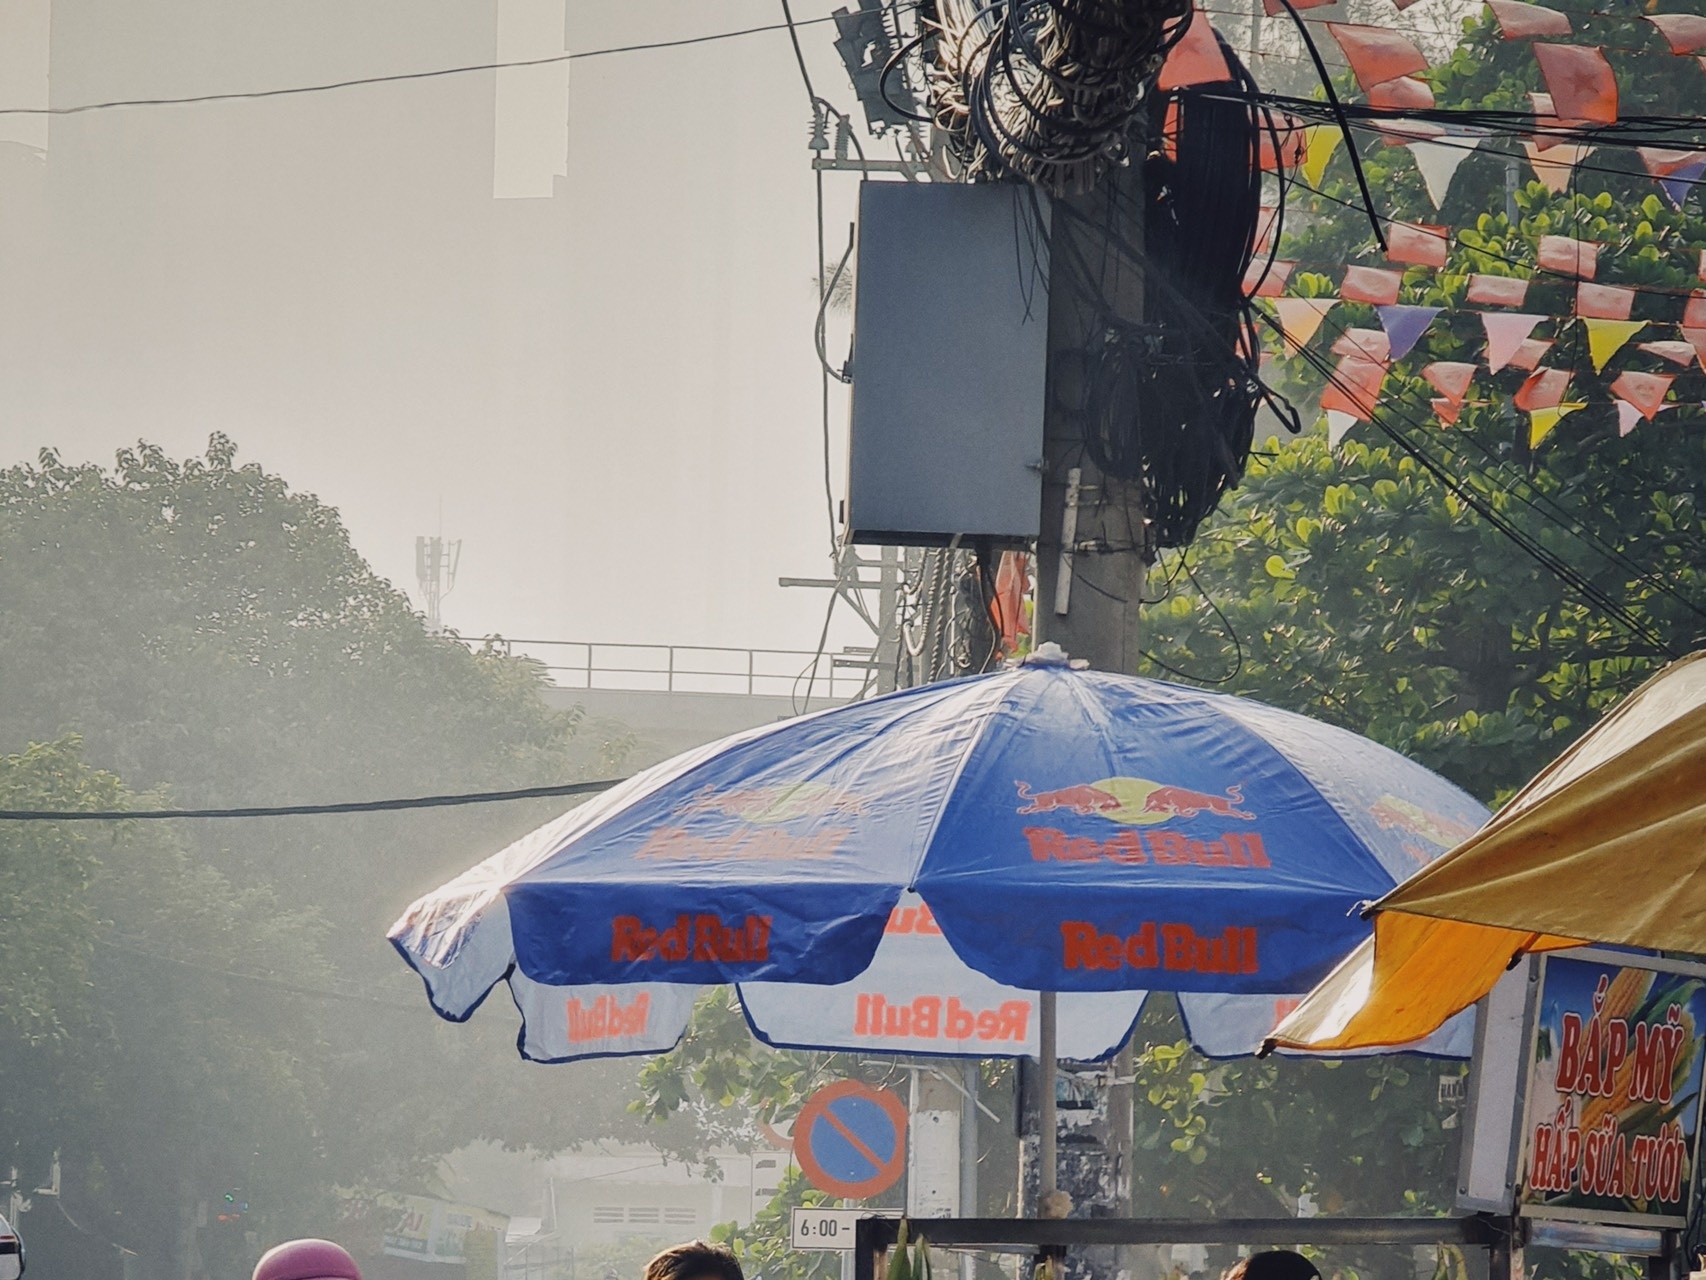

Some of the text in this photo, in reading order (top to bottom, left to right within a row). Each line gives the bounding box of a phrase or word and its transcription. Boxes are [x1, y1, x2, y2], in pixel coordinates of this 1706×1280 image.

[1022, 826, 1272, 869] Red Bull
[611, 914, 773, 964] Red Bull
[1060, 921, 1259, 975] Red Bull
[1556, 973, 1685, 1104] BẮP MỸ
[1529, 1096, 1582, 1192] HẤP
[1581, 1113, 1627, 1197] SỮA
[800, 1219, 837, 1237] 6:00
